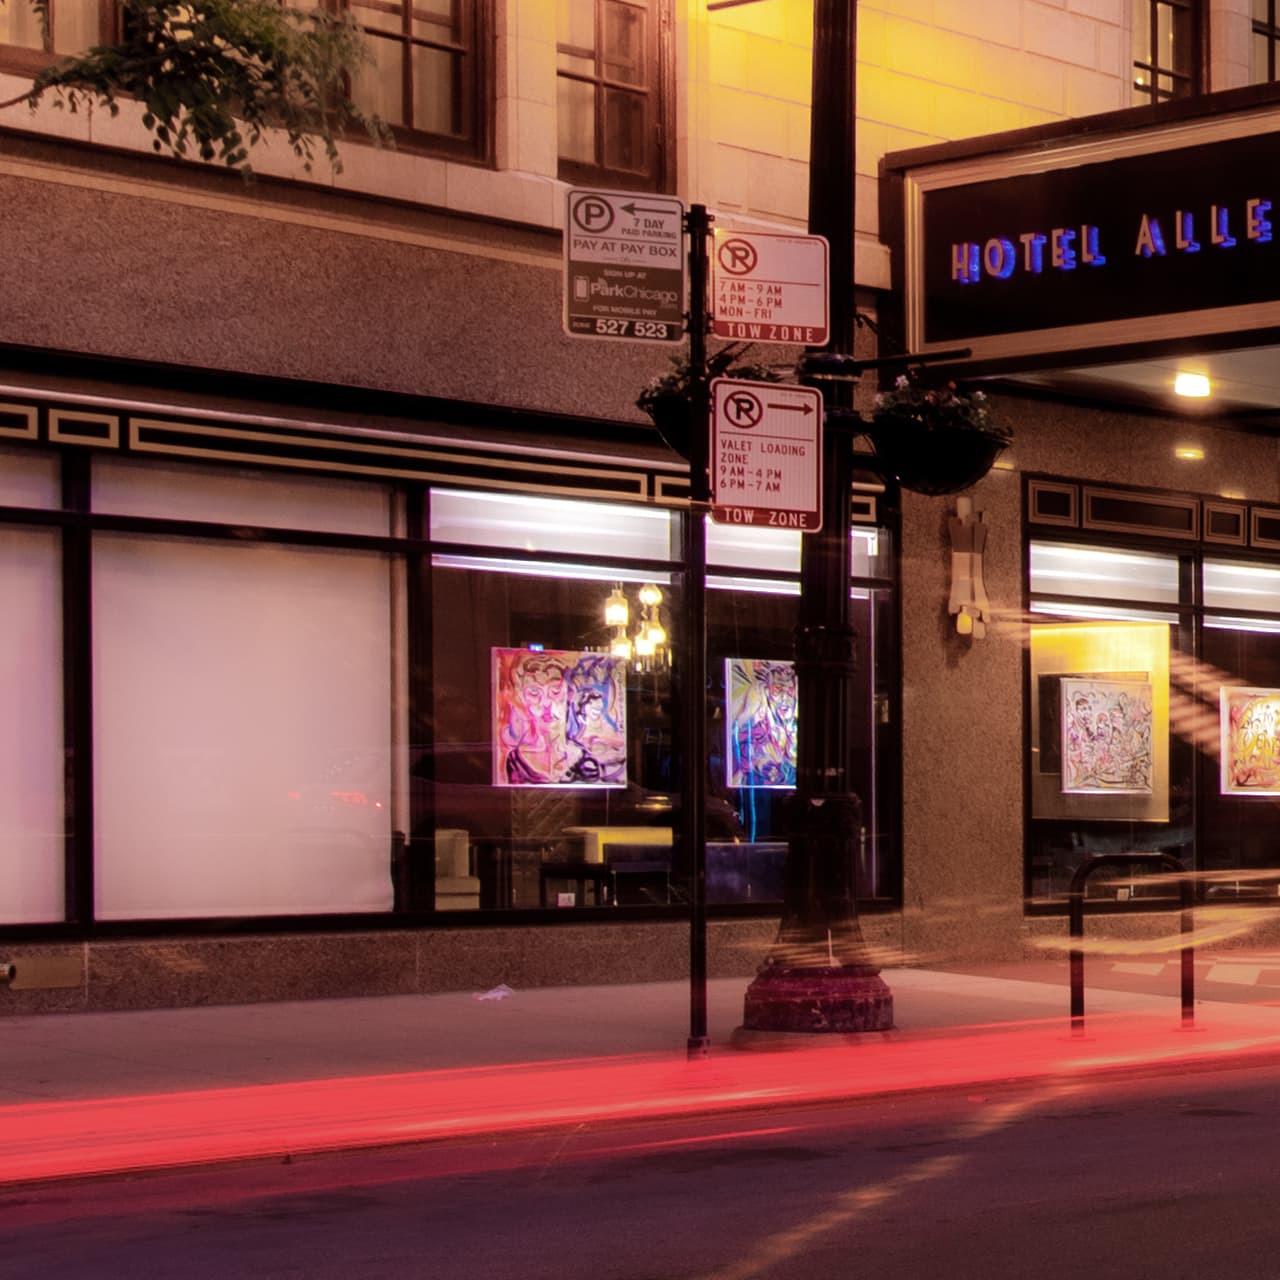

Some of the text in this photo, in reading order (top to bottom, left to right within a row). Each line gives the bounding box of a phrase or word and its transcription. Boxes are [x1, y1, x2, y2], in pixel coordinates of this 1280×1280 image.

[633, 219, 664, 229] 7 DAY
[642, 230, 676, 239] PARKING
[573, 240, 677, 258] PAY AT PAY BOX
[951, 224, 1106, 284] HOTEL
[591, 278, 678, 303] ParkChicago
[720, 282, 726, 290] 7
[730, 283, 745, 293] AM
[757, 284, 763, 293] 9
[767, 286, 782, 296] AM
[720, 294, 726, 303] 4
[730, 295, 745, 305] PM
[757, 297, 763, 306] 6
[767, 298, 782, 308] PM
[720, 306, 743, 317] MON
[754, 309, 772, 319] FRI
[596, 319, 629, 335] 527
[634, 322, 667, 338] 523
[727, 322, 814, 342] TOW ZONE
[721, 440, 806, 457] VALET LOADING
[720, 453, 748, 464] ZONE
[720, 465, 727, 475] 9
[730, 467, 745, 477] AM
[755, 468, 763, 478] 4
[766, 470, 782, 480] PM
[720, 479, 727, 489] 6
[730, 480, 745, 490] PM
[756, 481, 762, 490] 7
[765, 482, 781, 492] AM
[724, 508, 807, 528] TOW ZONE
